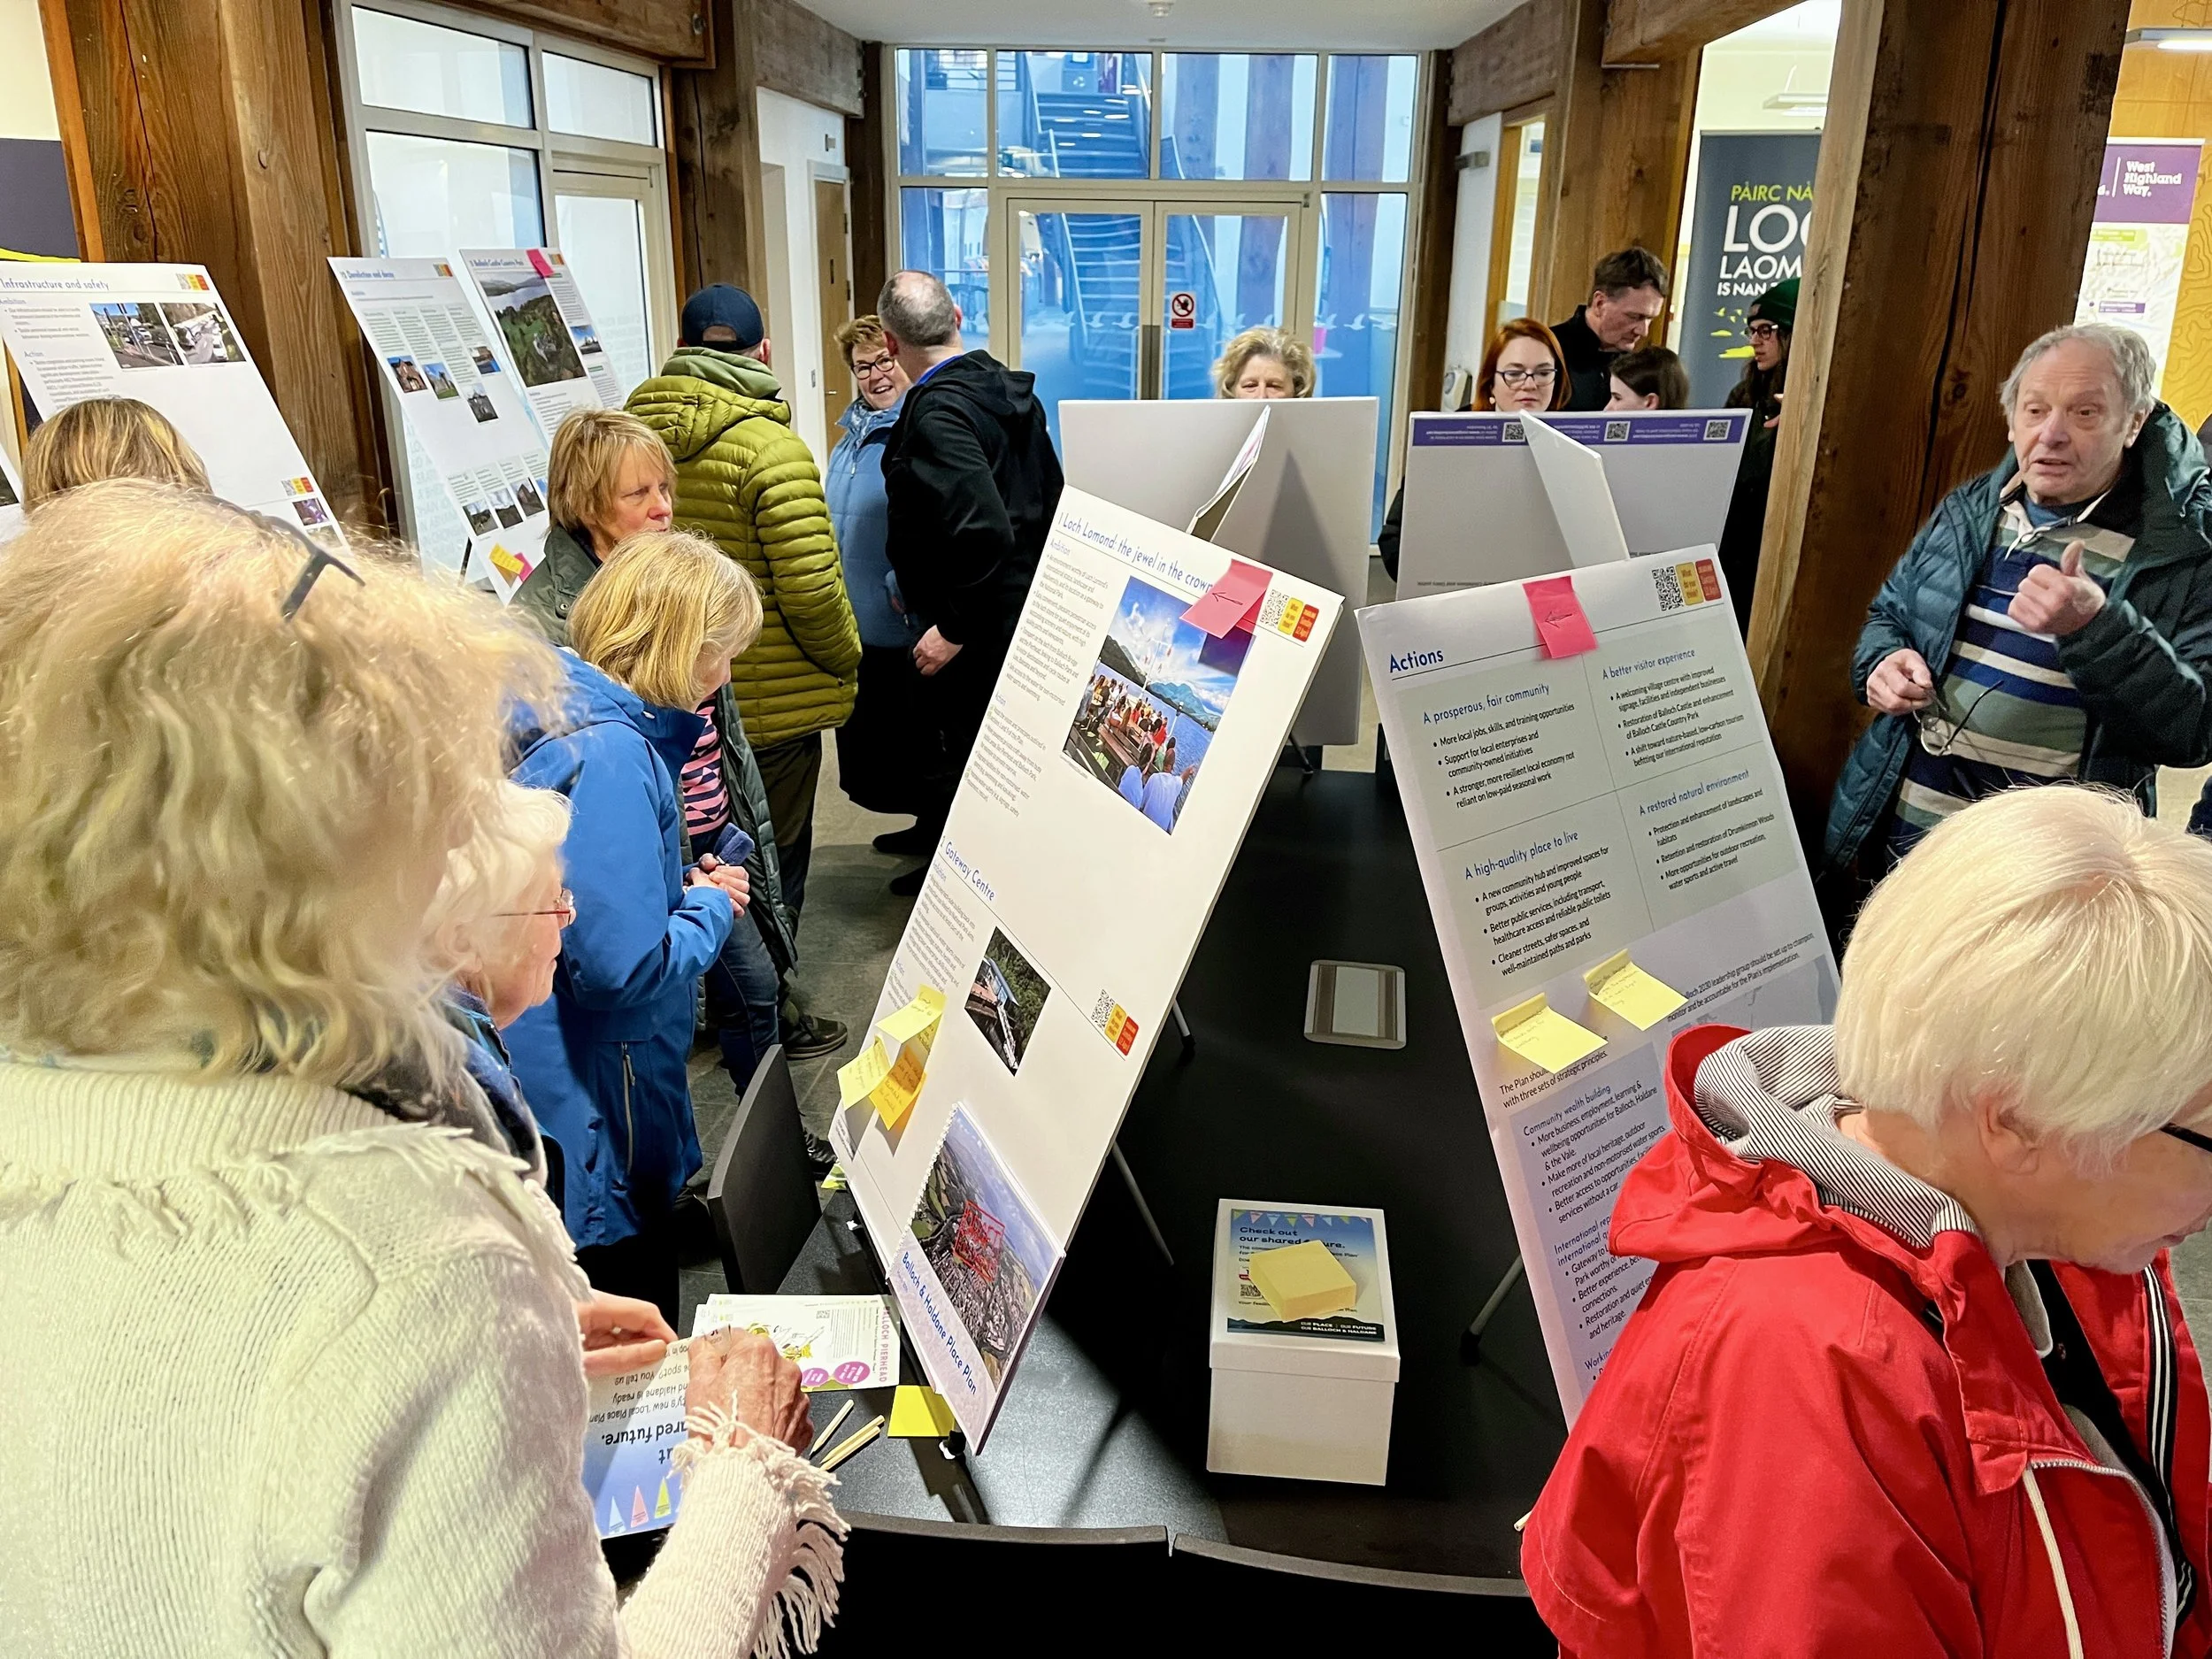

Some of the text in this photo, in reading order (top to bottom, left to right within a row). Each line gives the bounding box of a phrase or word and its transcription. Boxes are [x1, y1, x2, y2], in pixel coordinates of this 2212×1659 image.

[2124, 173, 2182, 185] Highland
[2126, 161, 2154, 173] West
[2124, 184, 2152, 197] Way.
[1, 278, 109, 290] Infrastructure and safety
[1717, 282, 1766, 296] IS NAN
[1063, 512, 1082, 534] Loch
[1081, 522, 1118, 549] Lomond:
[1117, 538, 1132, 557] the
[1131, 546, 1159, 568] jewel
[1156, 557, 1166, 573] in
[1167, 560, 1183, 580] the
[1389, 649, 1444, 673] Actions
[1602, 649, 1695, 680] A better visitor experience
[1424, 683, 1549, 725] A prosperous, fair community
[1622, 701, 1693, 728] Restoration of Balloch Castle
[1439, 703, 1575, 746] More local jobs, skills, and training opportunities
[1626, 710, 1700, 740] of Balloch Castle Country Park
[1444, 729, 1540, 765] Support for local enterprises and
[1448, 747, 1533, 778] community-owned initiatives
[1640, 769, 1749, 816] A restored natural environment
[1465, 831, 1578, 879] A high-quality place to live
[945, 841, 972, 879] Gateway
[972, 869, 995, 901] Centre
[1482, 892, 1488, 902] A
[1487, 888, 1502, 899] new
[1502, 875, 1534, 894] community
[1533, 870, 1546, 881] hub
[1545, 864, 1557, 877] and
[1555, 855, 1583, 872] improved
[1582, 850, 1601, 863] spaces
[1485, 870, 1582, 917] groups, activities and young people
[1497, 917, 1590, 964] Cleaner streets, safer spaces, and
[1502, 931, 1592, 976] well-maintained paths and parks
[1498, 1065, 1549, 1094] The Plan shou
[1502, 1050, 1608, 1109] with three sets of strategic principles.
[1523, 1085, 1611, 1136] Community wealth building
[1240, 1226, 1276, 1235] Check
[1262, 1236, 1301, 1245] shared
[1554, 1219, 1599, 1255] International
[1571, 1248, 1605, 1273] Gateway to
[1581, 1285, 1618, 1313] connections.
[902, 1251, 921, 1287] Balloch
[919, 1286, 926, 1298] &
[924, 1293, 946, 1340] Haldane
[946, 1336, 963, 1368] Place
[962, 1363, 977, 1395] Plan
[1589, 1310, 1626, 1340] and heritage.
[614, 1364, 681, 1386] spot? You tell us
[879, 1344, 889, 1382] PIERHEAD
[612, 1393, 634, 1405] ready
[646, 1386, 676, 1396] Haldane
[654, 1401, 669, 1410] new
[607, 1408, 627, 1419] Place
[602, 1421, 687, 1445] ared future.
